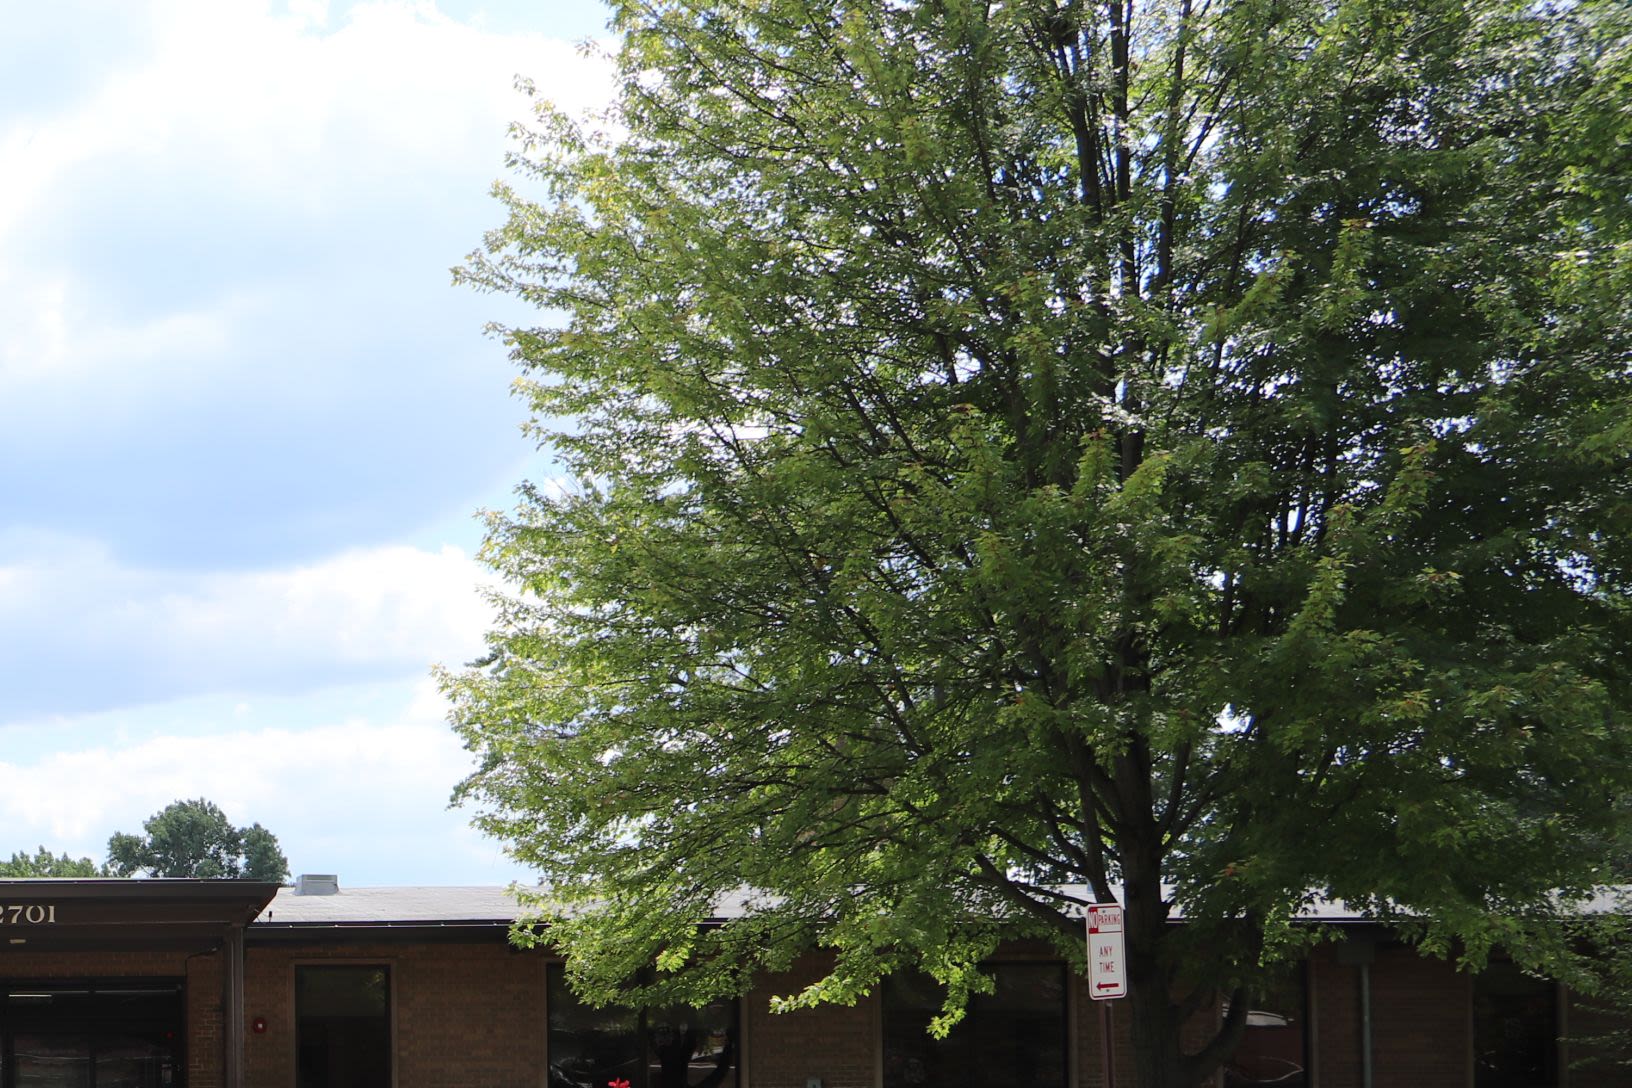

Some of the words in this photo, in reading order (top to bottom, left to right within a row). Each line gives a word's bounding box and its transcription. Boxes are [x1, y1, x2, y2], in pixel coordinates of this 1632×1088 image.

[1089, 911, 1098, 929] NO
[1098, 913, 1121, 926] PARKING
[1099, 946, 1113, 957] ANY
[1099, 961, 1115, 973] TIME
